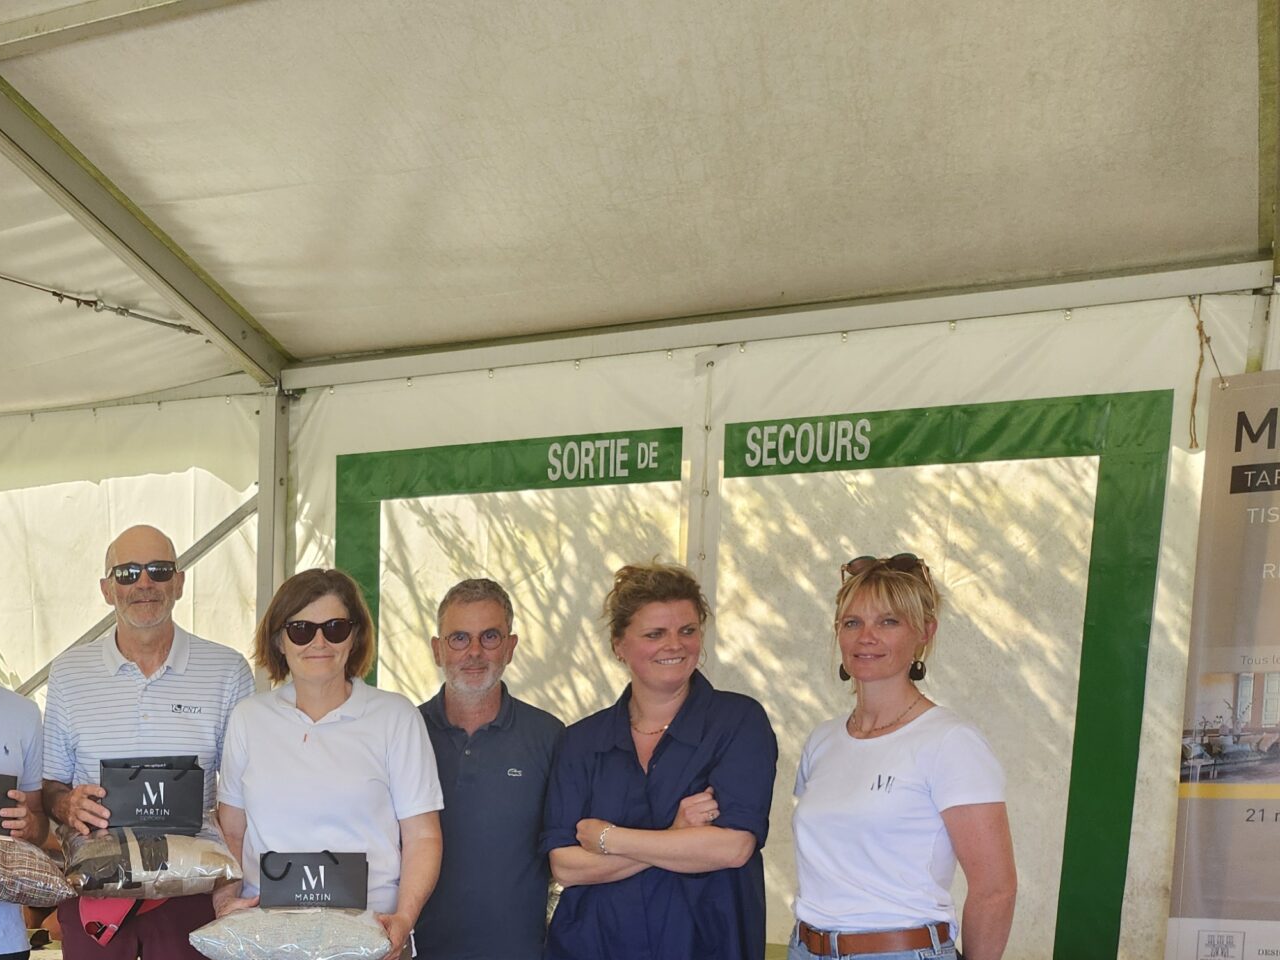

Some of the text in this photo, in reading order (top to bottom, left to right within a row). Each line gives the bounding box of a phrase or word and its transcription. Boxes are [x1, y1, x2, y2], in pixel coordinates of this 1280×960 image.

[745, 418, 871, 467] SECOURS
[547, 438, 659, 481] SORTIE DE
[1240, 655, 1268, 665] Tous
[135, 808, 170, 816] MARTIN
[1245, 808, 1265, 823] 21
[294, 893, 331, 901] MARTIN
